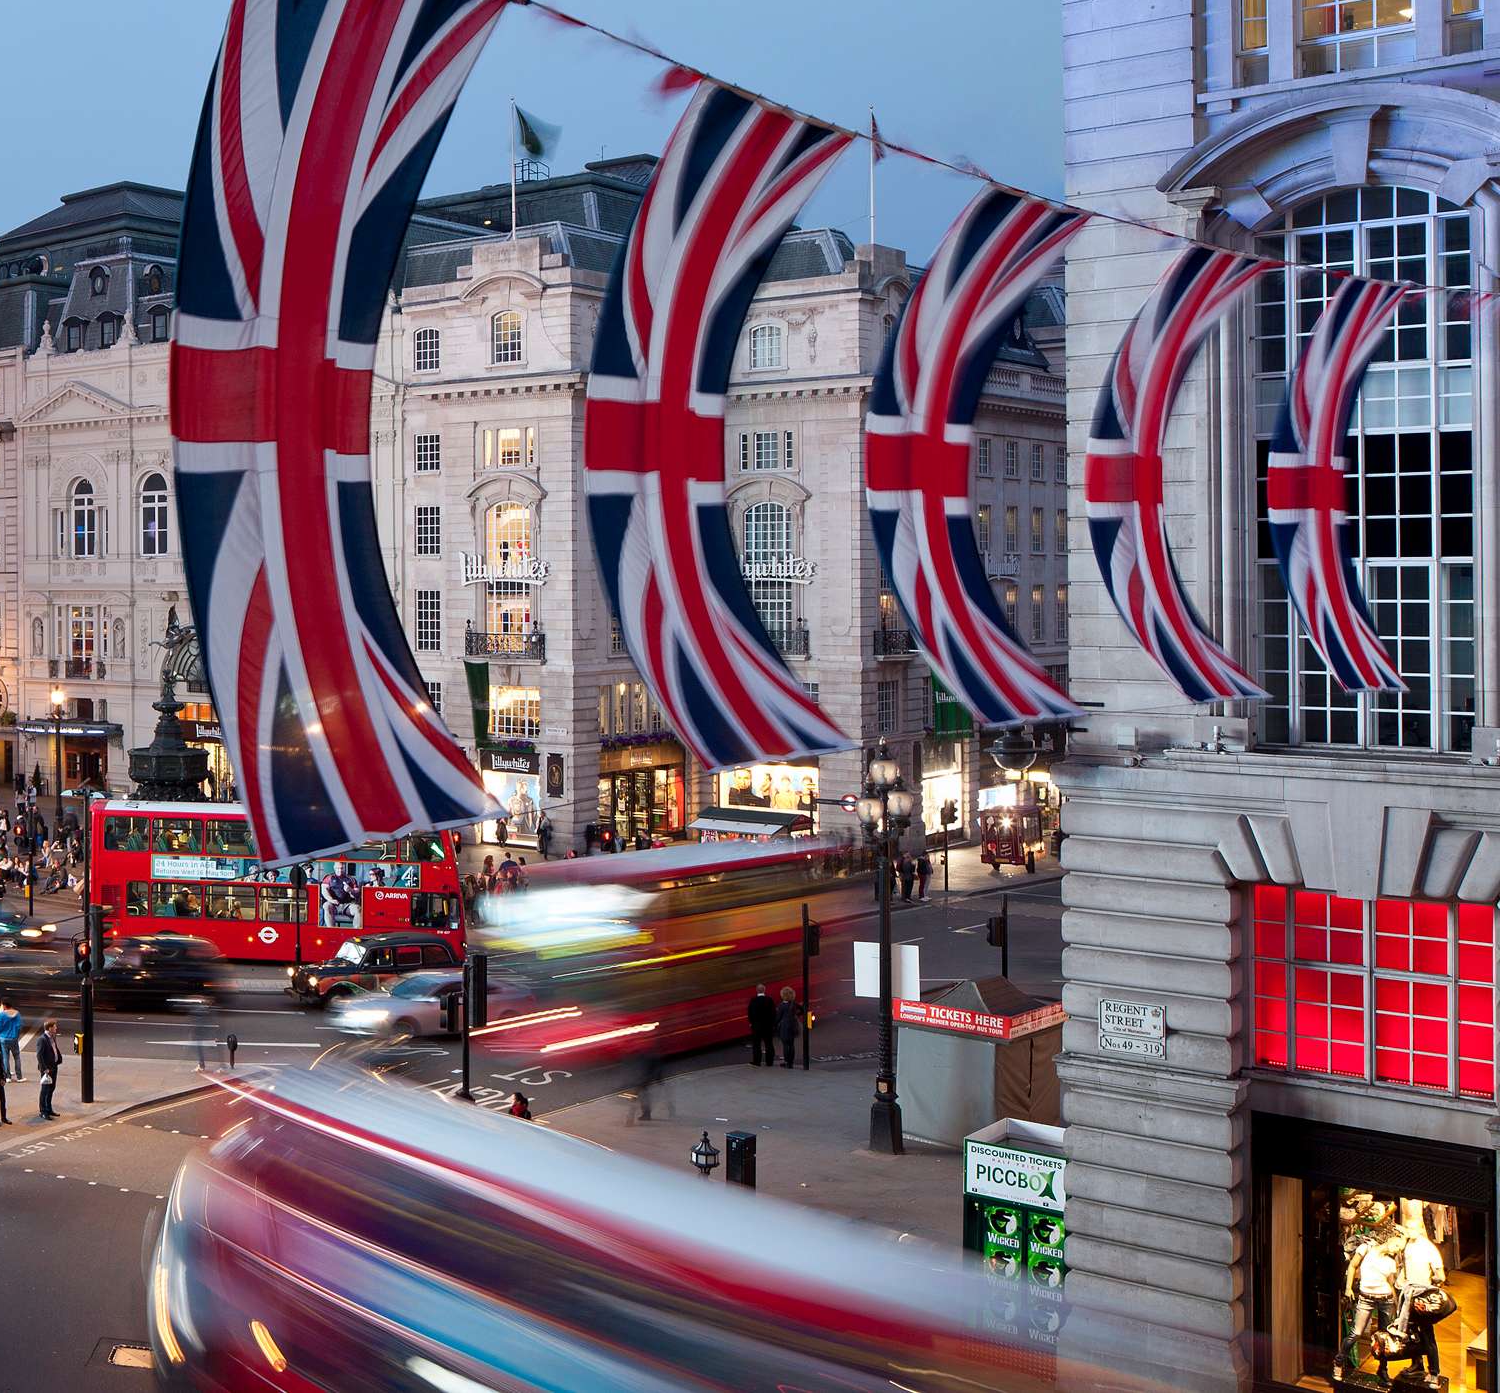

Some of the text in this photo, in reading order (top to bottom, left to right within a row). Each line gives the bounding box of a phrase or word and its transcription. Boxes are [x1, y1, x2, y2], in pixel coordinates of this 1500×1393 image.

[459, 550, 551, 587] Lillywhites
[491, 753, 531, 773] Lillywhites
[167, 860, 190, 868] Hours
[385, 892, 409, 900] ARRIVA
[929, 1006, 971, 1023] TICKETS
[975, 1014, 1004, 1029] HERE
[1104, 1002, 1148, 1017] REGENT
[900, 1013, 925, 1022] LONDON'S
[926, 1017, 949, 1026] PREMIER
[989, 1027, 1003, 1036] TOUR
[1104, 1014, 1145, 1028] STREET
[1122, 1040, 1133, 1051] 49
[1143, 1043, 1160, 1054] 319
[971, 1146, 1063, 1170] DISCOUNTED TICKETS
[976, 1163, 1058, 1202] PICCBOX
